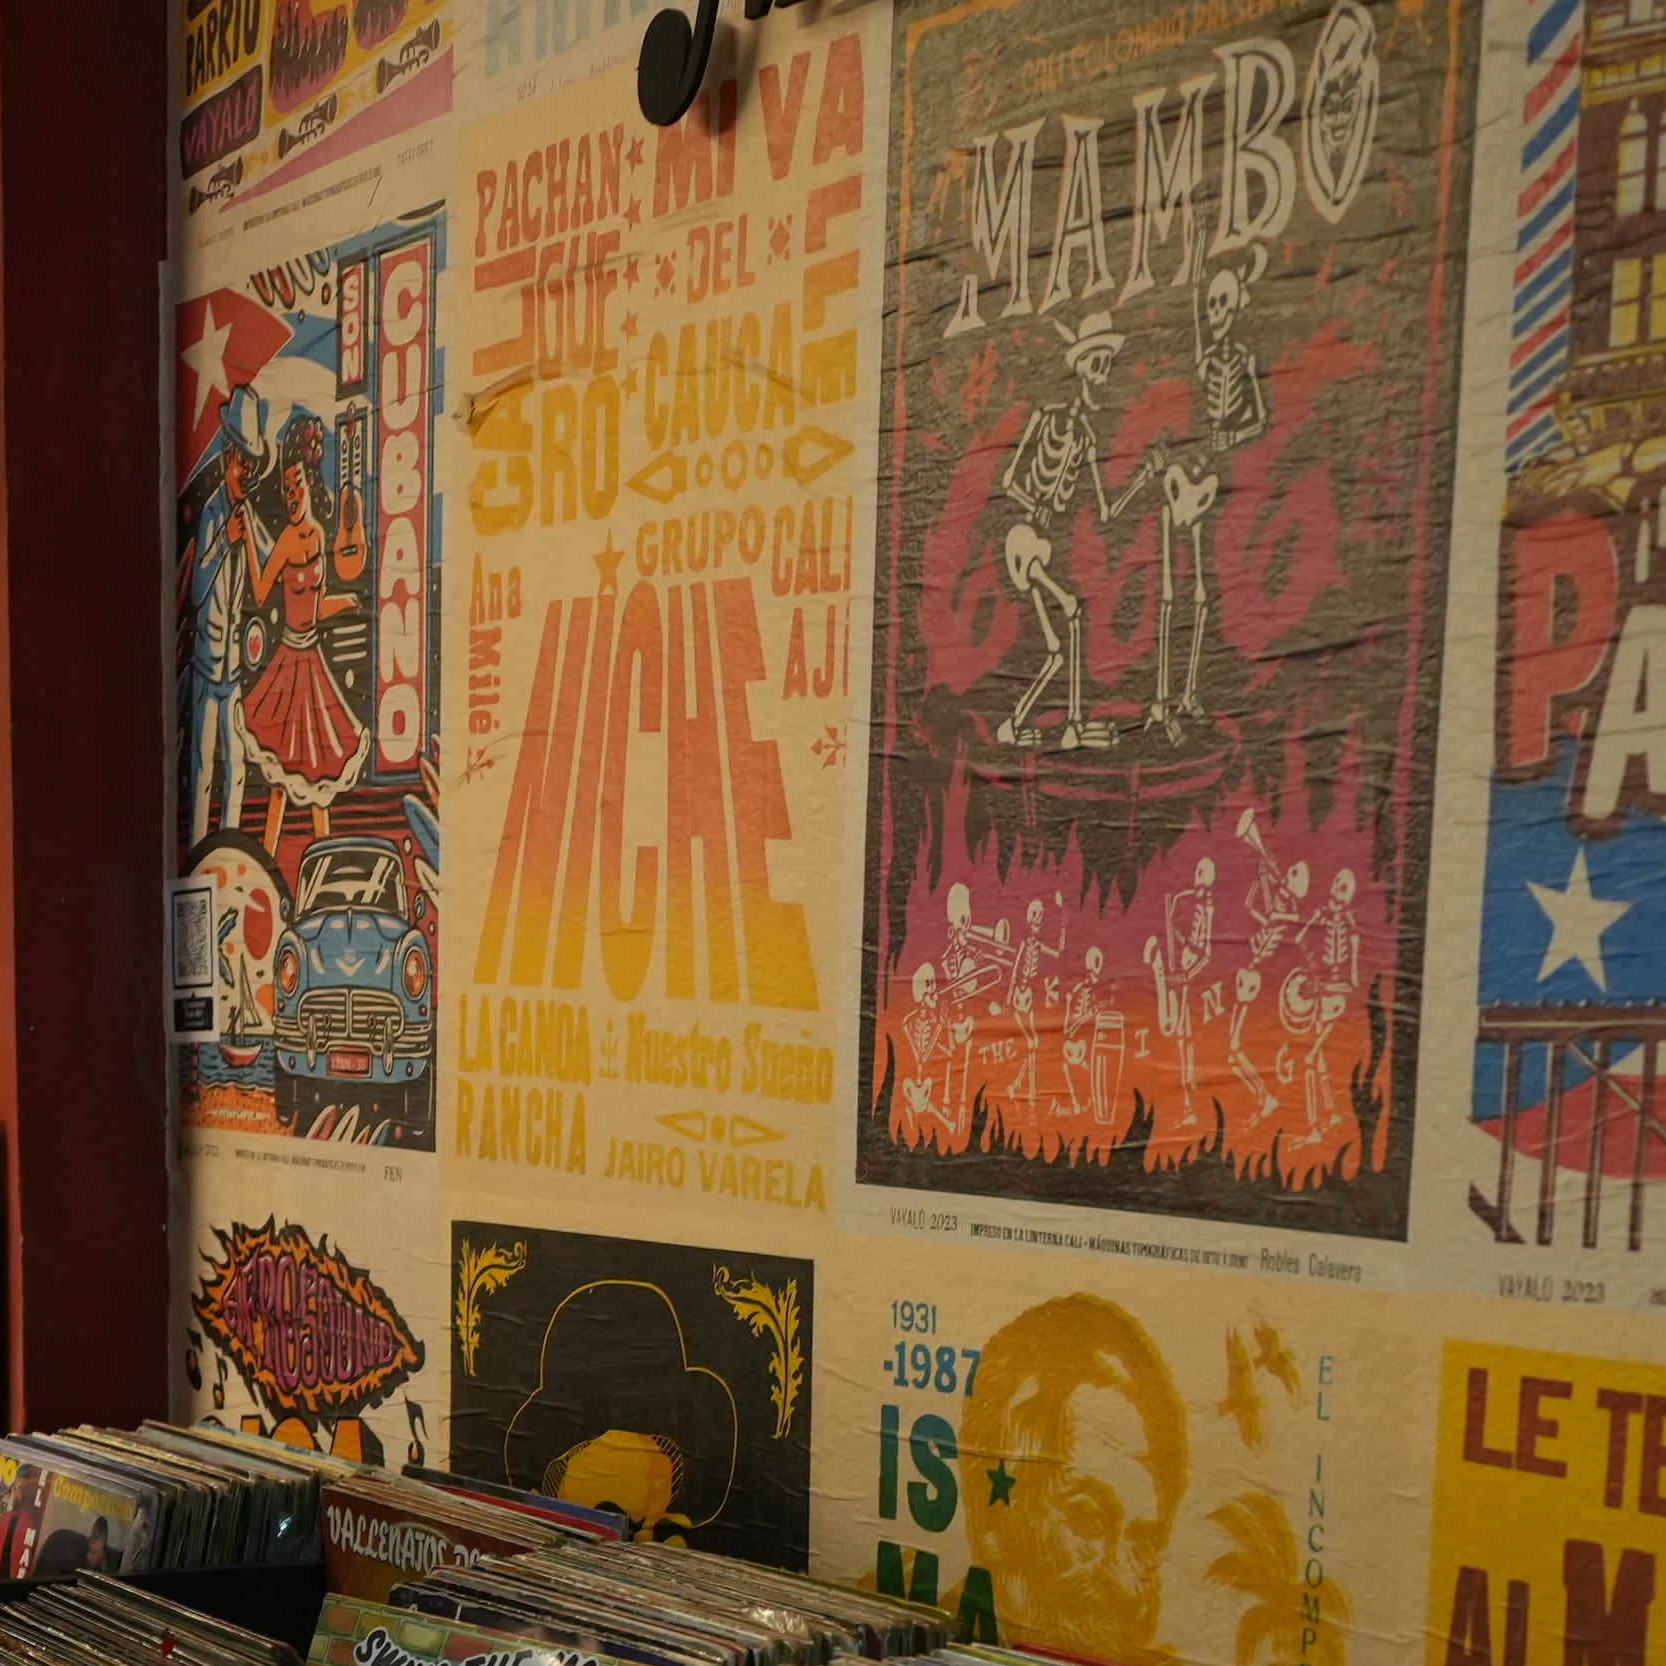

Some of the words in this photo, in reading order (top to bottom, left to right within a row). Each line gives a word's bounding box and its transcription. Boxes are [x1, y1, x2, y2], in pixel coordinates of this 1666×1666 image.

[184, 76, 260, 163] VAYALO
[475, 122, 624, 258] PACHAN
[943, 0, 1380, 338] MAMBO
[533, 231, 621, 375] GUE
[687, 213, 756, 303] DEL
[341, 275, 360, 384] SON
[642, 303, 794, 450] CAUCA
[539, 375, 621, 525] RO
[377, 260, 425, 762] CUBANO
[635, 505, 766, 578] GRUPO
[772, 496, 852, 597] CALI
[470, 553, 521, 625] Ana
[474, 577, 820, 1010] NICHE
[458, 994, 494, 1073] LA
[498, 1000, 592, 1086] CANOA
[627, 1011, 734, 1091] Nuestro
[742, 1022, 833, 1103] Sueño
[455, 1086, 587, 1175] RANCHA
[603, 1136, 686, 1186] JAIRO
[695, 1146, 827, 1211] VARELA
[891, 1207, 926, 1231] VAYALO
[930, 1213, 958, 1232] 2023
[971, 1223, 1002, 1240] IMPRESO
[1003, 1227, 1013, 1241] EN
[1014, 1228, 1024, 1242] LA
[1261, 1247, 1301, 1275] Robles
[1308, 1252, 1362, 1284] Calavera
[1498, 1272, 1554, 1302] VAYALO
[1561, 1278, 1607, 1304] 2023
[890, 1300, 937, 1335] 1931
[883, 1340, 981, 1398] -1987
[879, 1404, 960, 1533] IS
[1461, 1367, 1574, 1479] LE
[327, 1504, 447, 1575] VALLENATOS
